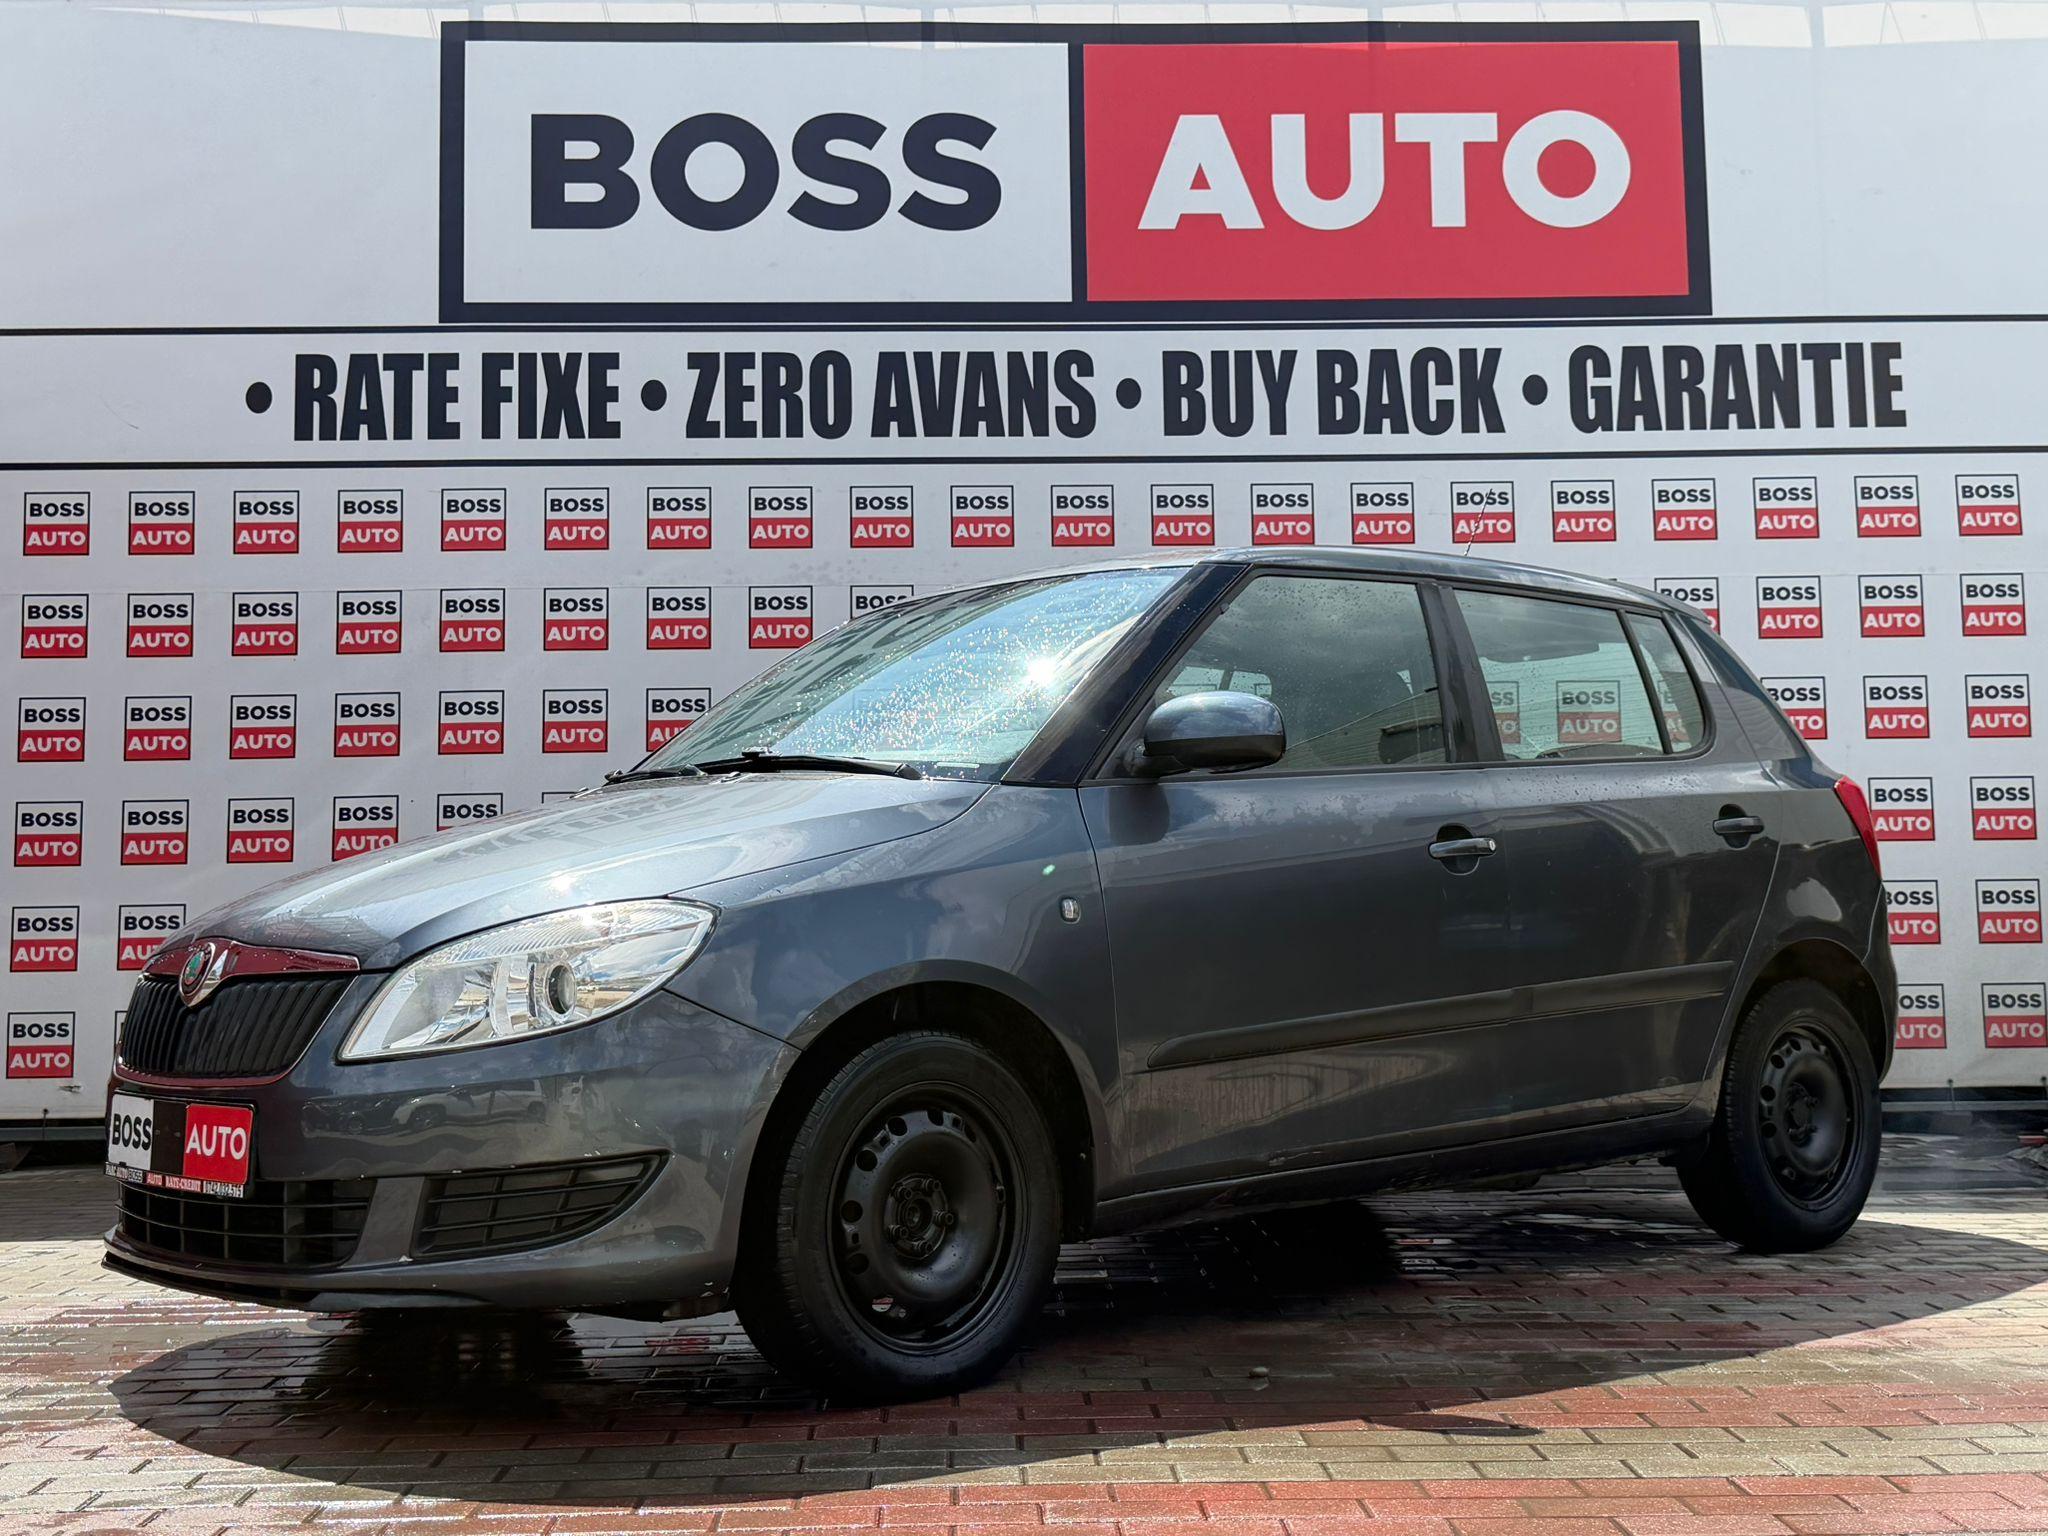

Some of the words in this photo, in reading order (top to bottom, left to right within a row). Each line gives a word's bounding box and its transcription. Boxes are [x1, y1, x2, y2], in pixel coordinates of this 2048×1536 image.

[531, 113, 1001, 231] BOSS
[1138, 110, 1630, 230] AUTO
[294, 352, 460, 441] RATE
[482, 352, 621, 440] FIXE
[686, 350, 852, 439] ZERO
[871, 350, 1096, 438] AVANS
[1163, 350, 1297, 437] BUY
[1317, 347, 1505, 435] BACK
[1569, 343, 1906, 433] GARANTIE
[1457, 492, 1509, 505] BOSS
[1557, 491, 1609, 504] BOSS
[1658, 489, 1710, 502] BOSS
[1760, 488, 1812, 501] BOSS
[1861, 486, 1913, 499] BOSS
[1962, 485, 2014, 498] BOSS
[447, 499, 501, 512] BOSS
[551, 498, 604, 512] BOSS
[653, 498, 706, 511] BOSS
[755, 497, 807, 510] BOSS
[856, 496, 908, 509] BOSS
[957, 496, 1008, 509] BOSS
[1057, 496, 1108, 508] BOSS
[1157, 495, 1208, 508] BOSS
[1257, 494, 1308, 507] BOSS
[1357, 493, 1408, 506] BOSS
[30, 503, 84, 516] BOSS
[135, 502, 189, 516] BOSS
[240, 501, 294, 515] BOSS
[344, 500, 397, 514] BOSS
[1456, 519, 1512, 534] AUTO
[1556, 518, 1613, 532] AUTO
[1657, 516, 1714, 531] AUTO
[1758, 515, 1816, 529] AUTO
[1860, 513, 1918, 528] AUTO
[1961, 512, 2019, 527] AUTO
[445, 527, 502, 542] AUTO
[548, 526, 605, 540] AUTO
[651, 526, 707, 539] AUTO
[753, 525, 809, 539] AUTO
[853, 524, 910, 538] AUTO
[955, 524, 1010, 537] AUTO
[1054, 523, 1111, 537] AUTO
[1155, 522, 1211, 536] AUTO
[1255, 521, 1311, 536] AUTO
[1355, 520, 1411, 535] AUTO
[27, 531, 85, 546] AUTO
[132, 531, 190, 545] AUTO
[237, 530, 295, 544] AUTO
[341, 529, 399, 543] AUTO
[1763, 587, 1815, 600] BOSS
[1865, 585, 1917, 599] BOSS
[1967, 584, 2019, 597] BOSS
[239, 603, 292, 617] BOSS
[343, 601, 396, 615] BOSS
[446, 599, 500, 613] BOSS
[550, 598, 603, 612] BOSS
[653, 597, 706, 611] BOSS
[755, 596, 807, 610] BOSS
[28, 605, 83, 619] BOSS
[134, 604, 188, 618] BOSS
[1761, 614, 1819, 629] AUTO
[1864, 614, 1921, 628] AUTO
[1965, 612, 2023, 627] AUTO
[236, 631, 294, 646] AUTO
[340, 630, 398, 644] AUTO
[443, 627, 501, 642] AUTO
[547, 626, 605, 641] AUTO
[650, 626, 707, 640] AUTO
[753, 625, 809, 639] AUTO
[25, 634, 83, 648] AUTO
[130, 633, 189, 647] AUTO
[1562, 691, 1615, 705] BOSS
[1870, 687, 1922, 700] BOSS
[1972, 685, 2024, 698] BOSS
[237, 705, 291, 720] BOSS
[341, 703, 395, 717] BOSS
[445, 701, 498, 715] BOSS
[549, 700, 602, 714] BOSS
[652, 699, 705, 712] BOSS
[25, 708, 80, 722] BOSS
[131, 707, 186, 721] BOSS
[1970, 713, 2028, 728] AUTO
[1562, 719, 1617, 734] AUTO
[1868, 714, 1926, 729] AUTO
[234, 734, 292, 749] AUTO
[338, 732, 396, 747] AUTO
[442, 730, 500, 744] AUTO
[546, 728, 604, 743] AUTO
[22, 738, 81, 752] AUTO
[128, 736, 187, 750] AUTO
[1875, 788, 1927, 802] BOSS
[1977, 787, 2029, 801] BOSS
[128, 811, 183, 825] BOSS
[234, 809, 288, 823] BOSS
[339, 806, 393, 821] BOSS
[443, 804, 497, 818] BOSS
[22, 812, 77, 826] BOSS
[1875, 816, 1931, 831] AUTO
[1976, 816, 2033, 830] AUTO
[20, 842, 77, 856] AUTO
[125, 840, 184, 855] AUTO
[231, 838, 289, 853] AUTO
[336, 835, 394, 850] AUTO
[1982, 890, 2035, 904] BOSS
[18, 917, 73, 932] BOSS
[125, 916, 179, 930] BOSS
[1982, 919, 2038, 933] AUTO
[14, 947, 74, 961] AUTO
[1900, 995, 1940, 1009] OSS
[1988, 994, 2041, 1008] BOSS
[13, 1023, 69, 1038] BOSS
[1896, 1023, 1942, 1039] UTO
[1988, 1023, 2043, 1037] AUTO
[10, 1053, 69, 1068] AUTO
[112, 1113, 152, 1151] BOSS
[186, 1123, 247, 1160] AUTO
